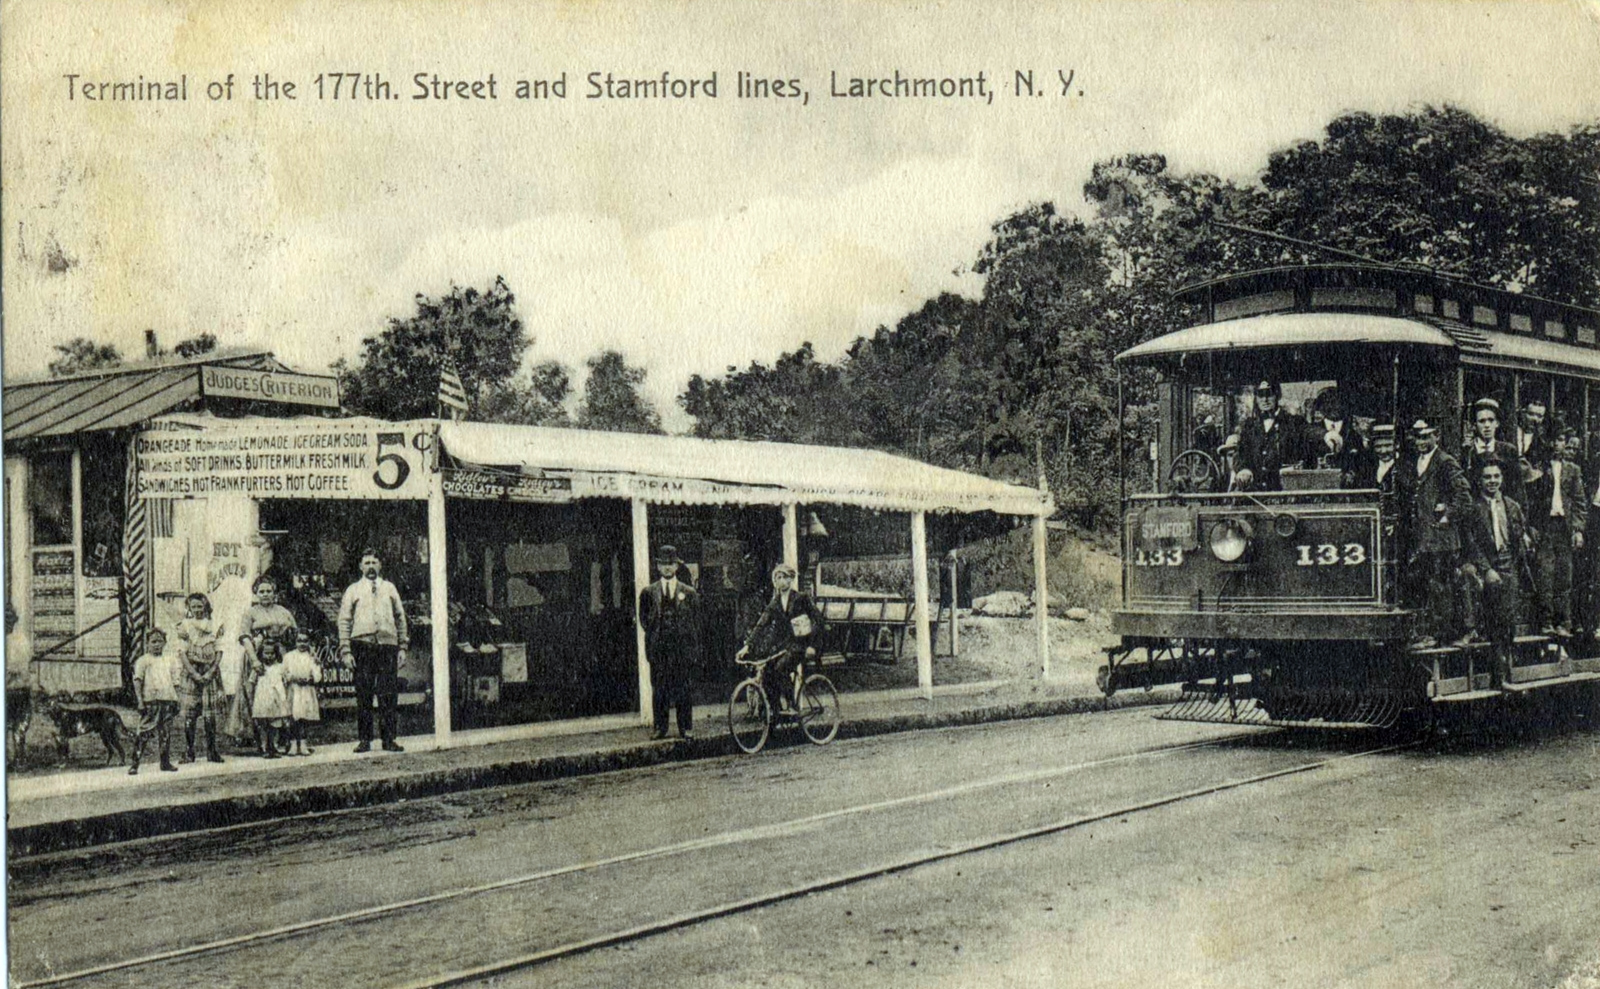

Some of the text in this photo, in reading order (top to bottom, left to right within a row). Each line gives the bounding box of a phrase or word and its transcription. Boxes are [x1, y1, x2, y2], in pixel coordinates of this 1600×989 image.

[260, 373, 332, 399] CRITERION
[138, 438, 191, 454] ORANGEADE
[184, 455, 206, 471] SOFT
[246, 452, 305, 471] BUTTERMILK
[308, 453, 340, 469] FRESH
[137, 476, 191, 493] SANDWICHES
[193, 476, 209, 493] HOT
[286, 473, 305, 491] HOT
[442, 481, 504, 496] CHOCOLATES
[591, 475, 618, 491] ICE
[213, 542, 242, 557] HOT
[1135, 545, 1183, 566] 133
[1296, 543, 1366, 566] 133
